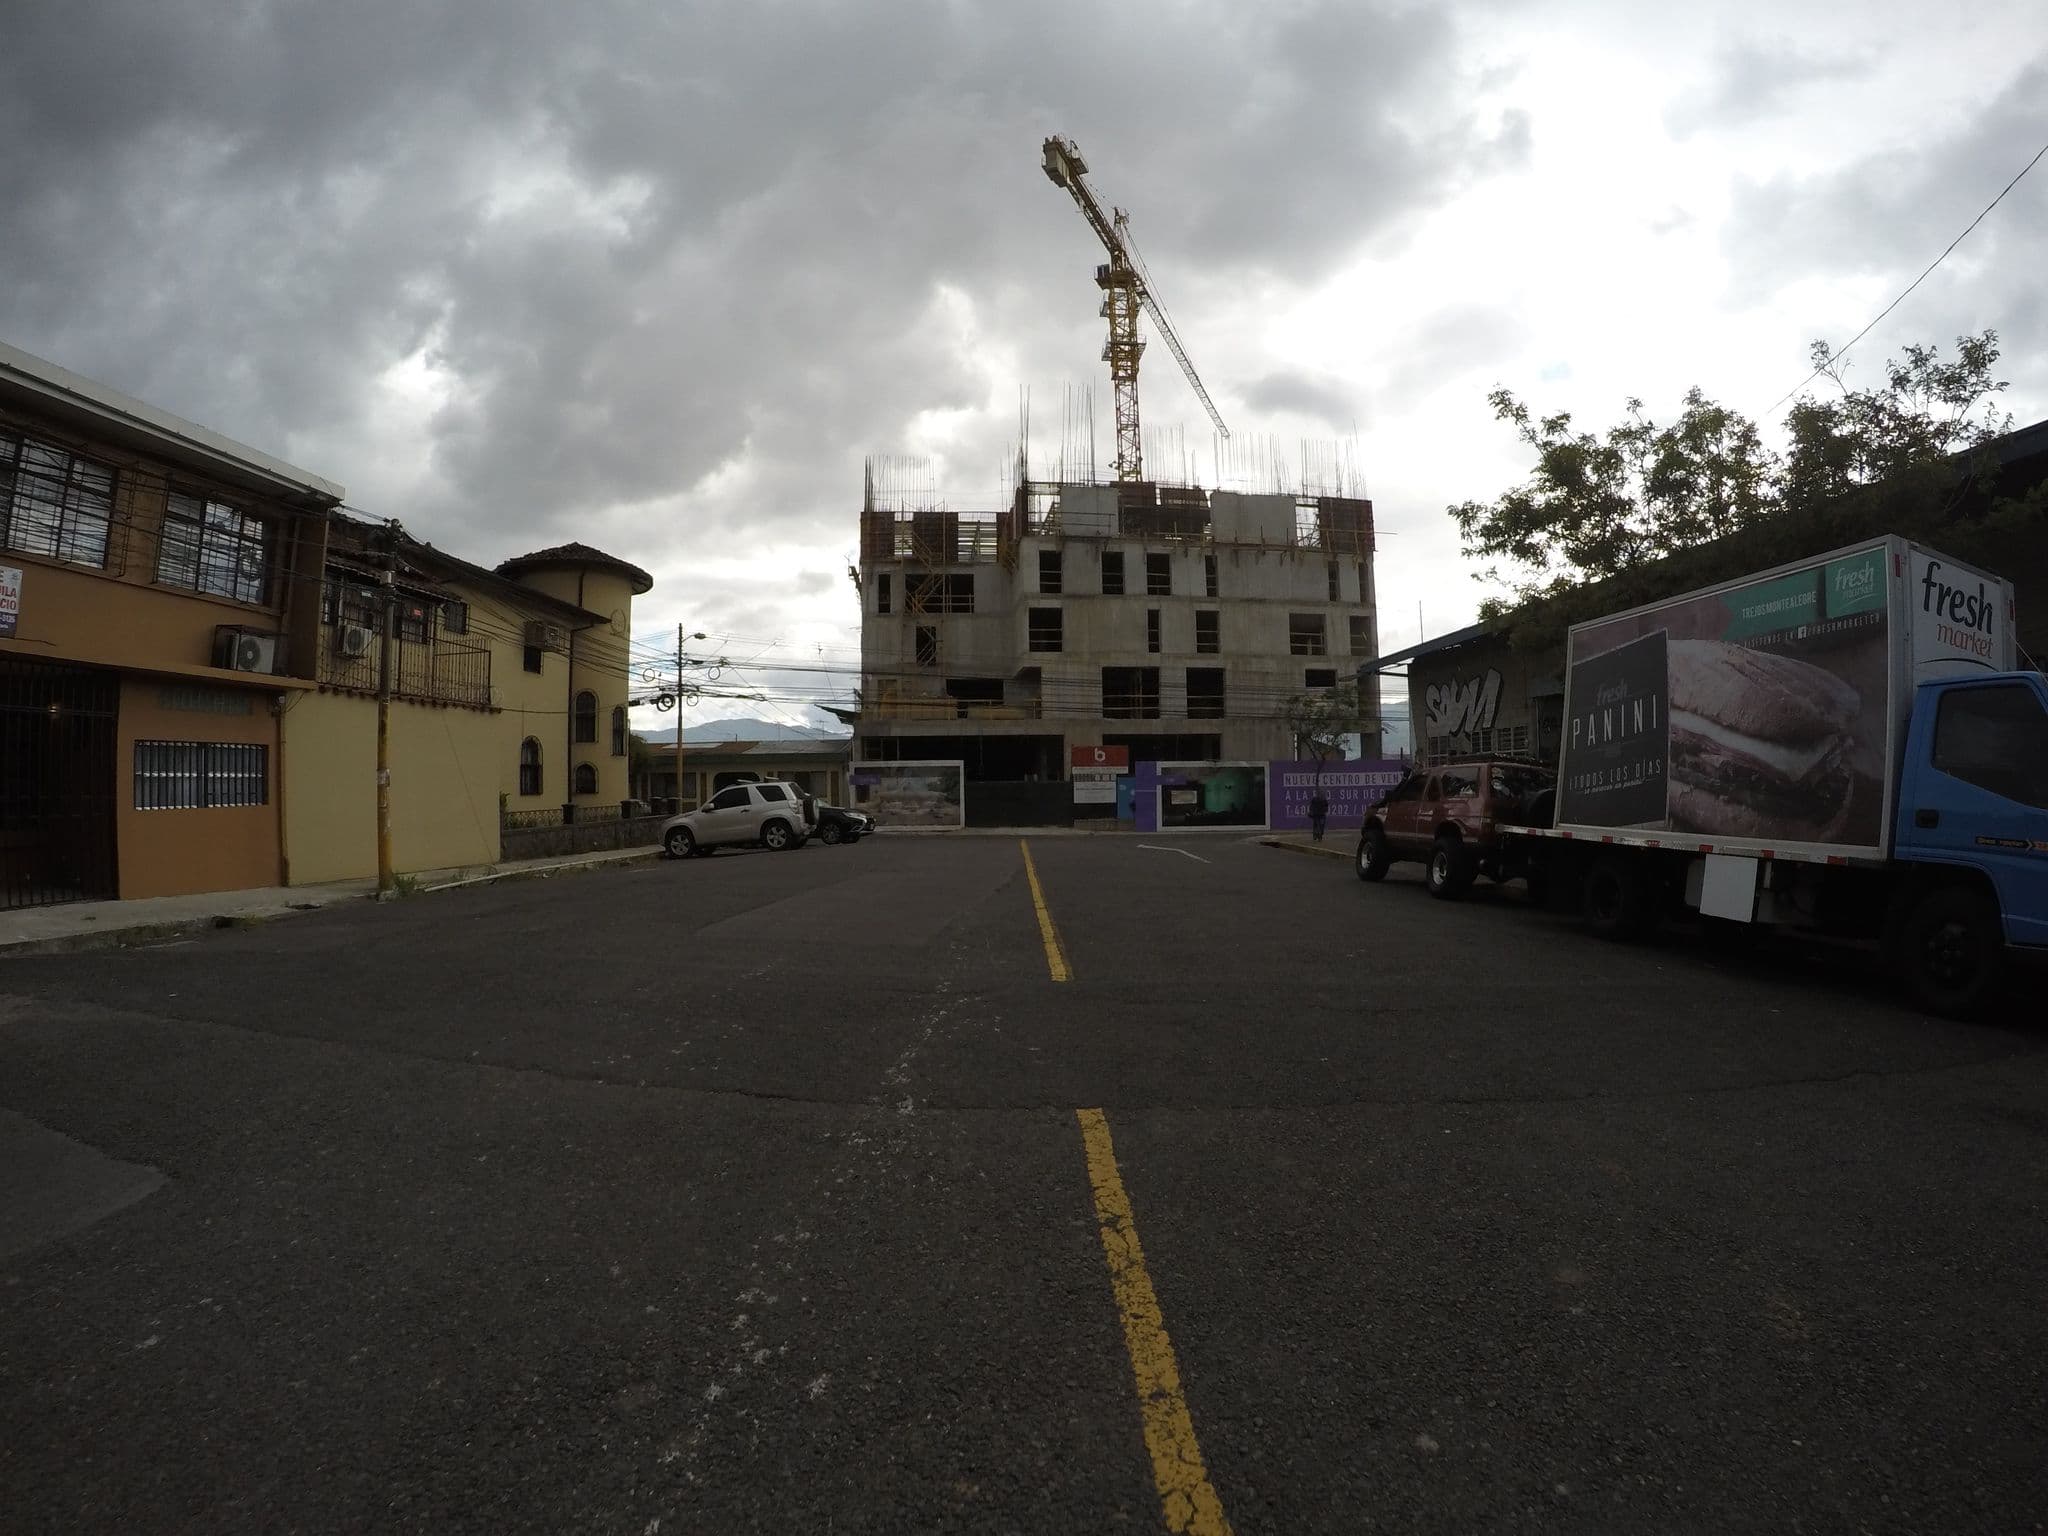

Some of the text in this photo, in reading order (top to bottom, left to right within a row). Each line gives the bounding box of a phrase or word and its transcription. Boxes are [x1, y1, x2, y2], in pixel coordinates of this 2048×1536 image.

[1834, 560, 1874, 591] fresh
[1922, 561, 1993, 635] fresh
[1936, 624, 1994, 659] market
[1572, 694, 1657, 750] PANINI
[1285, 774, 1318, 785] NUEVO
[1323, 774, 1360, 785] CENTRO
[1365, 773, 1376, 784] DE
[1285, 789, 1292, 800] A
[1296, 789, 1308, 800] LA
[1339, 789, 1359, 800] SUR
[1363, 789, 1375, 799] DE
